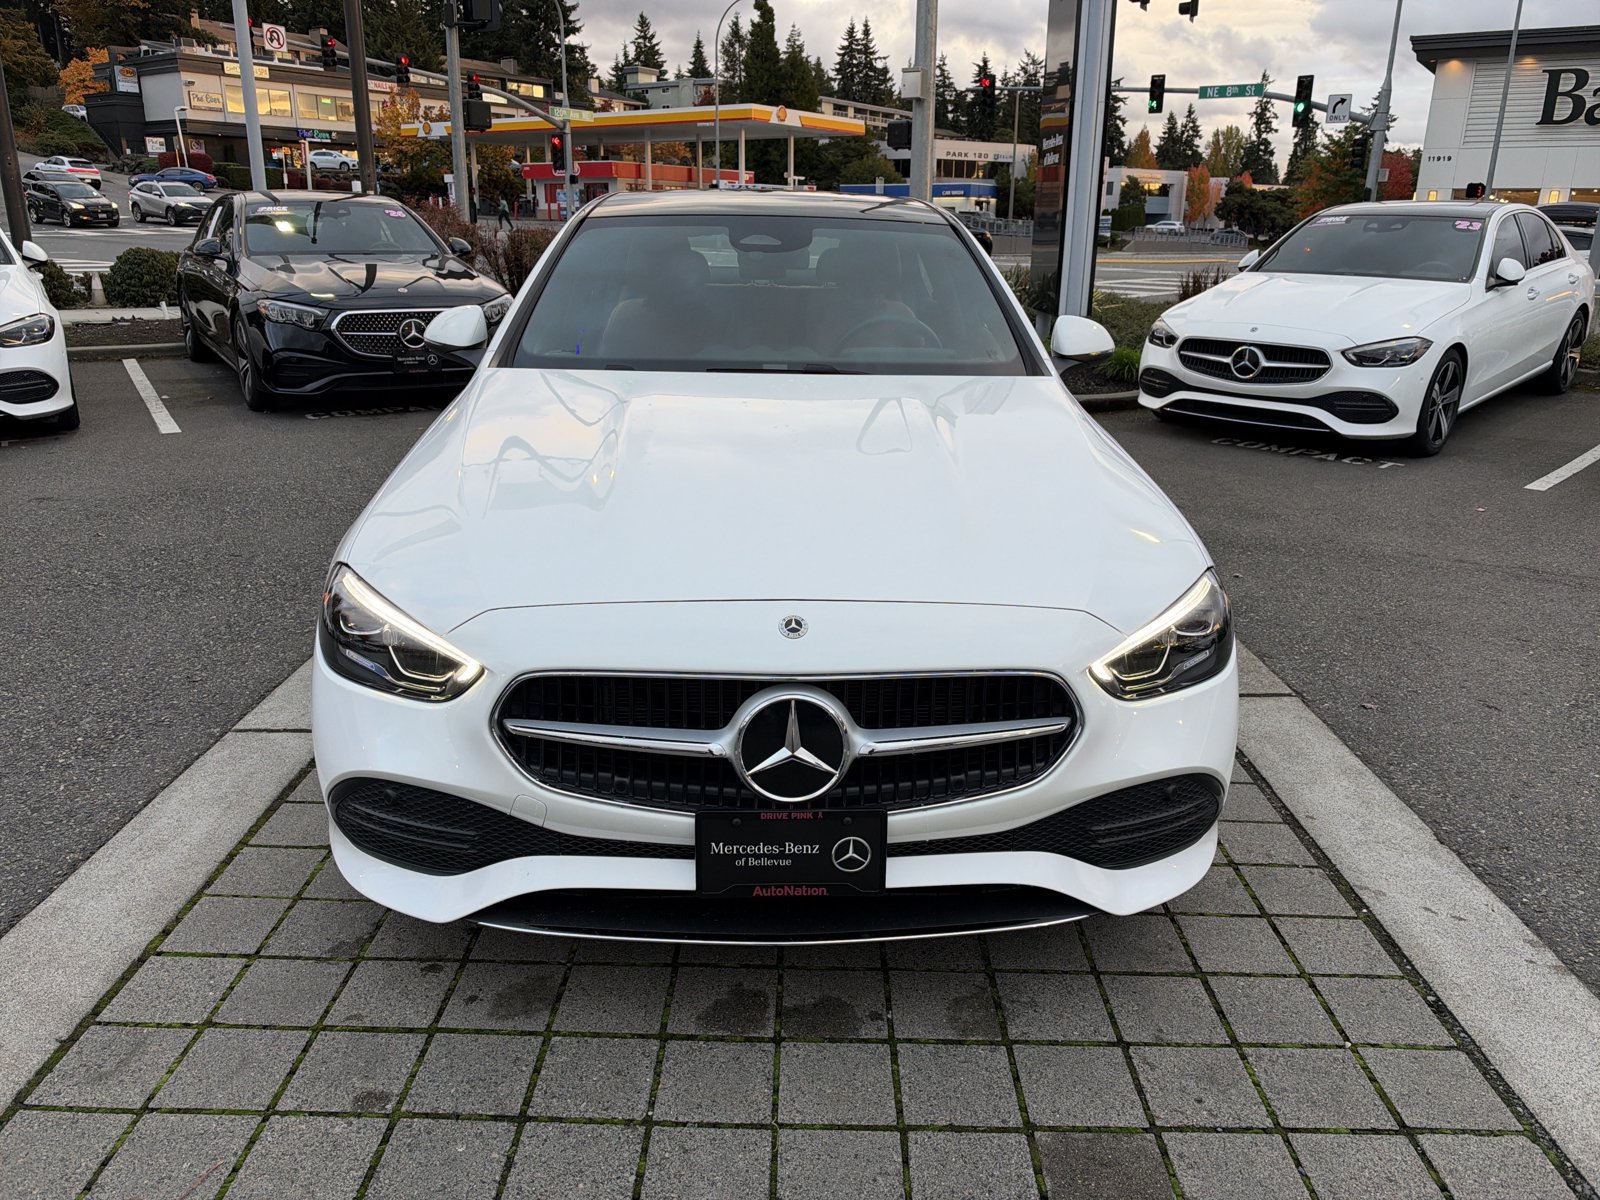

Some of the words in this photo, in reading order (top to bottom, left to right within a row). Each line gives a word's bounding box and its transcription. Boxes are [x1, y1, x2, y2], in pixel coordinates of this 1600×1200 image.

[1206, 87, 1220, 97] NE
[1225, 86, 1239, 97] 8th
[1245, 86, 1256, 96] St
[1535, 68, 1600, 126] Ba
[1210, 437, 1405, 469] COMPACT
[760, 812, 789, 820] DRIVE
[791, 811, 814, 820] PINK
[710, 841, 820, 855] Mercedes-Benz
[735, 857, 746, 867] of
[748, 857, 792, 867] Bellevue
[752, 885, 827, 897] AutoNation
